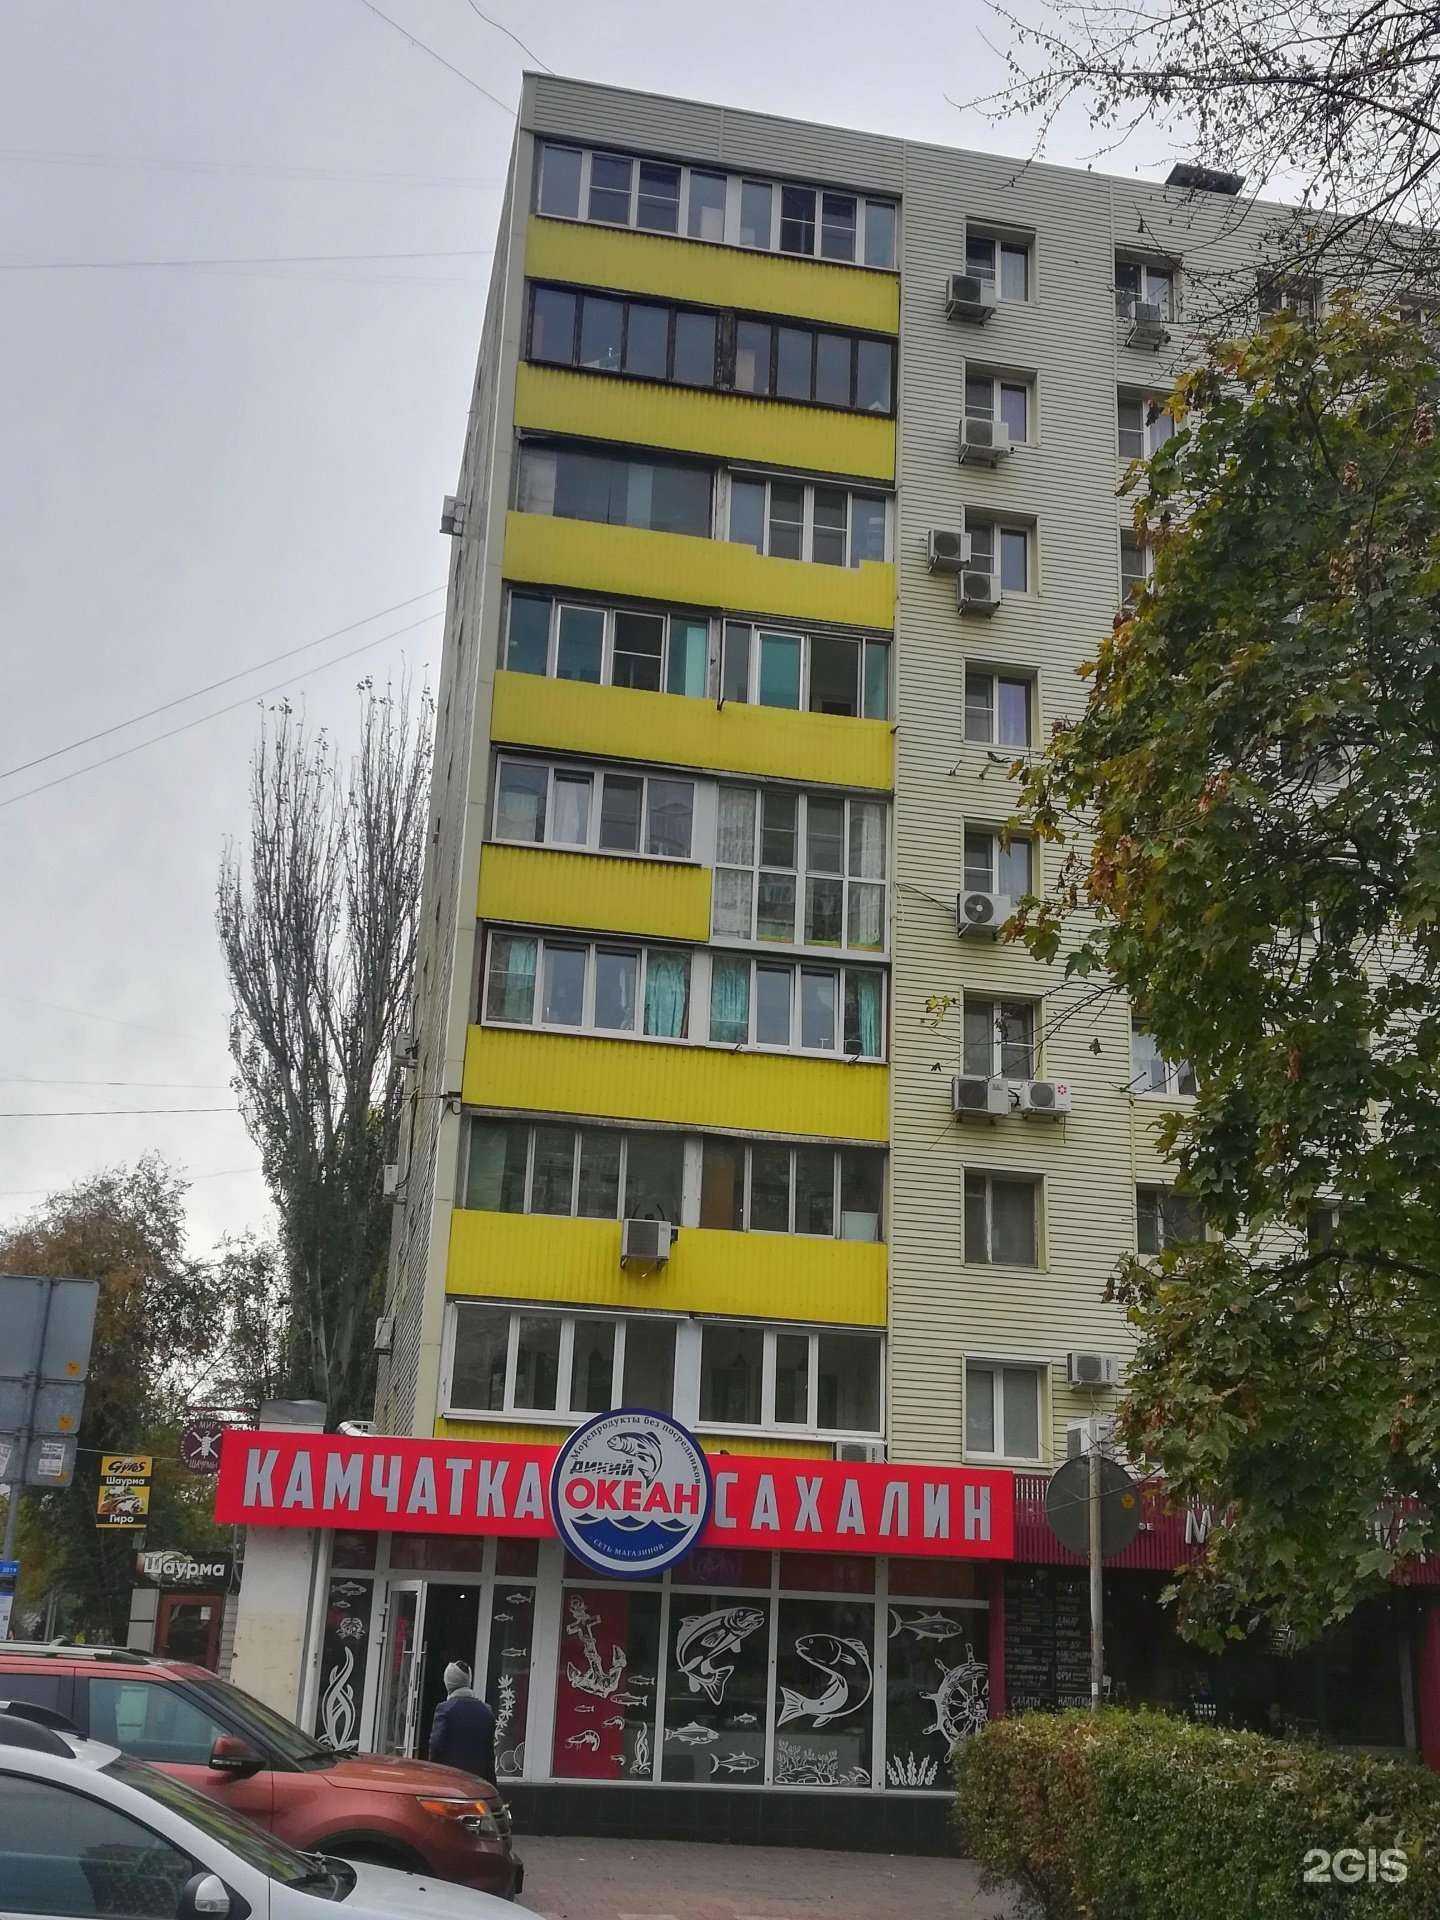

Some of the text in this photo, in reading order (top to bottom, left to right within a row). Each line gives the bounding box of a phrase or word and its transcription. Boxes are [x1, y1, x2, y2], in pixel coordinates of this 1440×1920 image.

[571, 1416, 701, 1483] Морепродукты без посредников
[570, 1459, 634, 1476] ДИКИЙ
[106, 1476, 145, 1486] Шаурма
[243, 1448, 545, 1520] КАМЧАТКА
[564, 1477, 700, 1515] ОКЕАН
[714, 1471, 991, 1541] САХАЛИН
[109, 1514, 134, 1524] Гиро
[593, 1538, 665, 1557] СЕТЬ МАГАЗИНОВ
[143, 1557, 225, 1579] Шаурма
